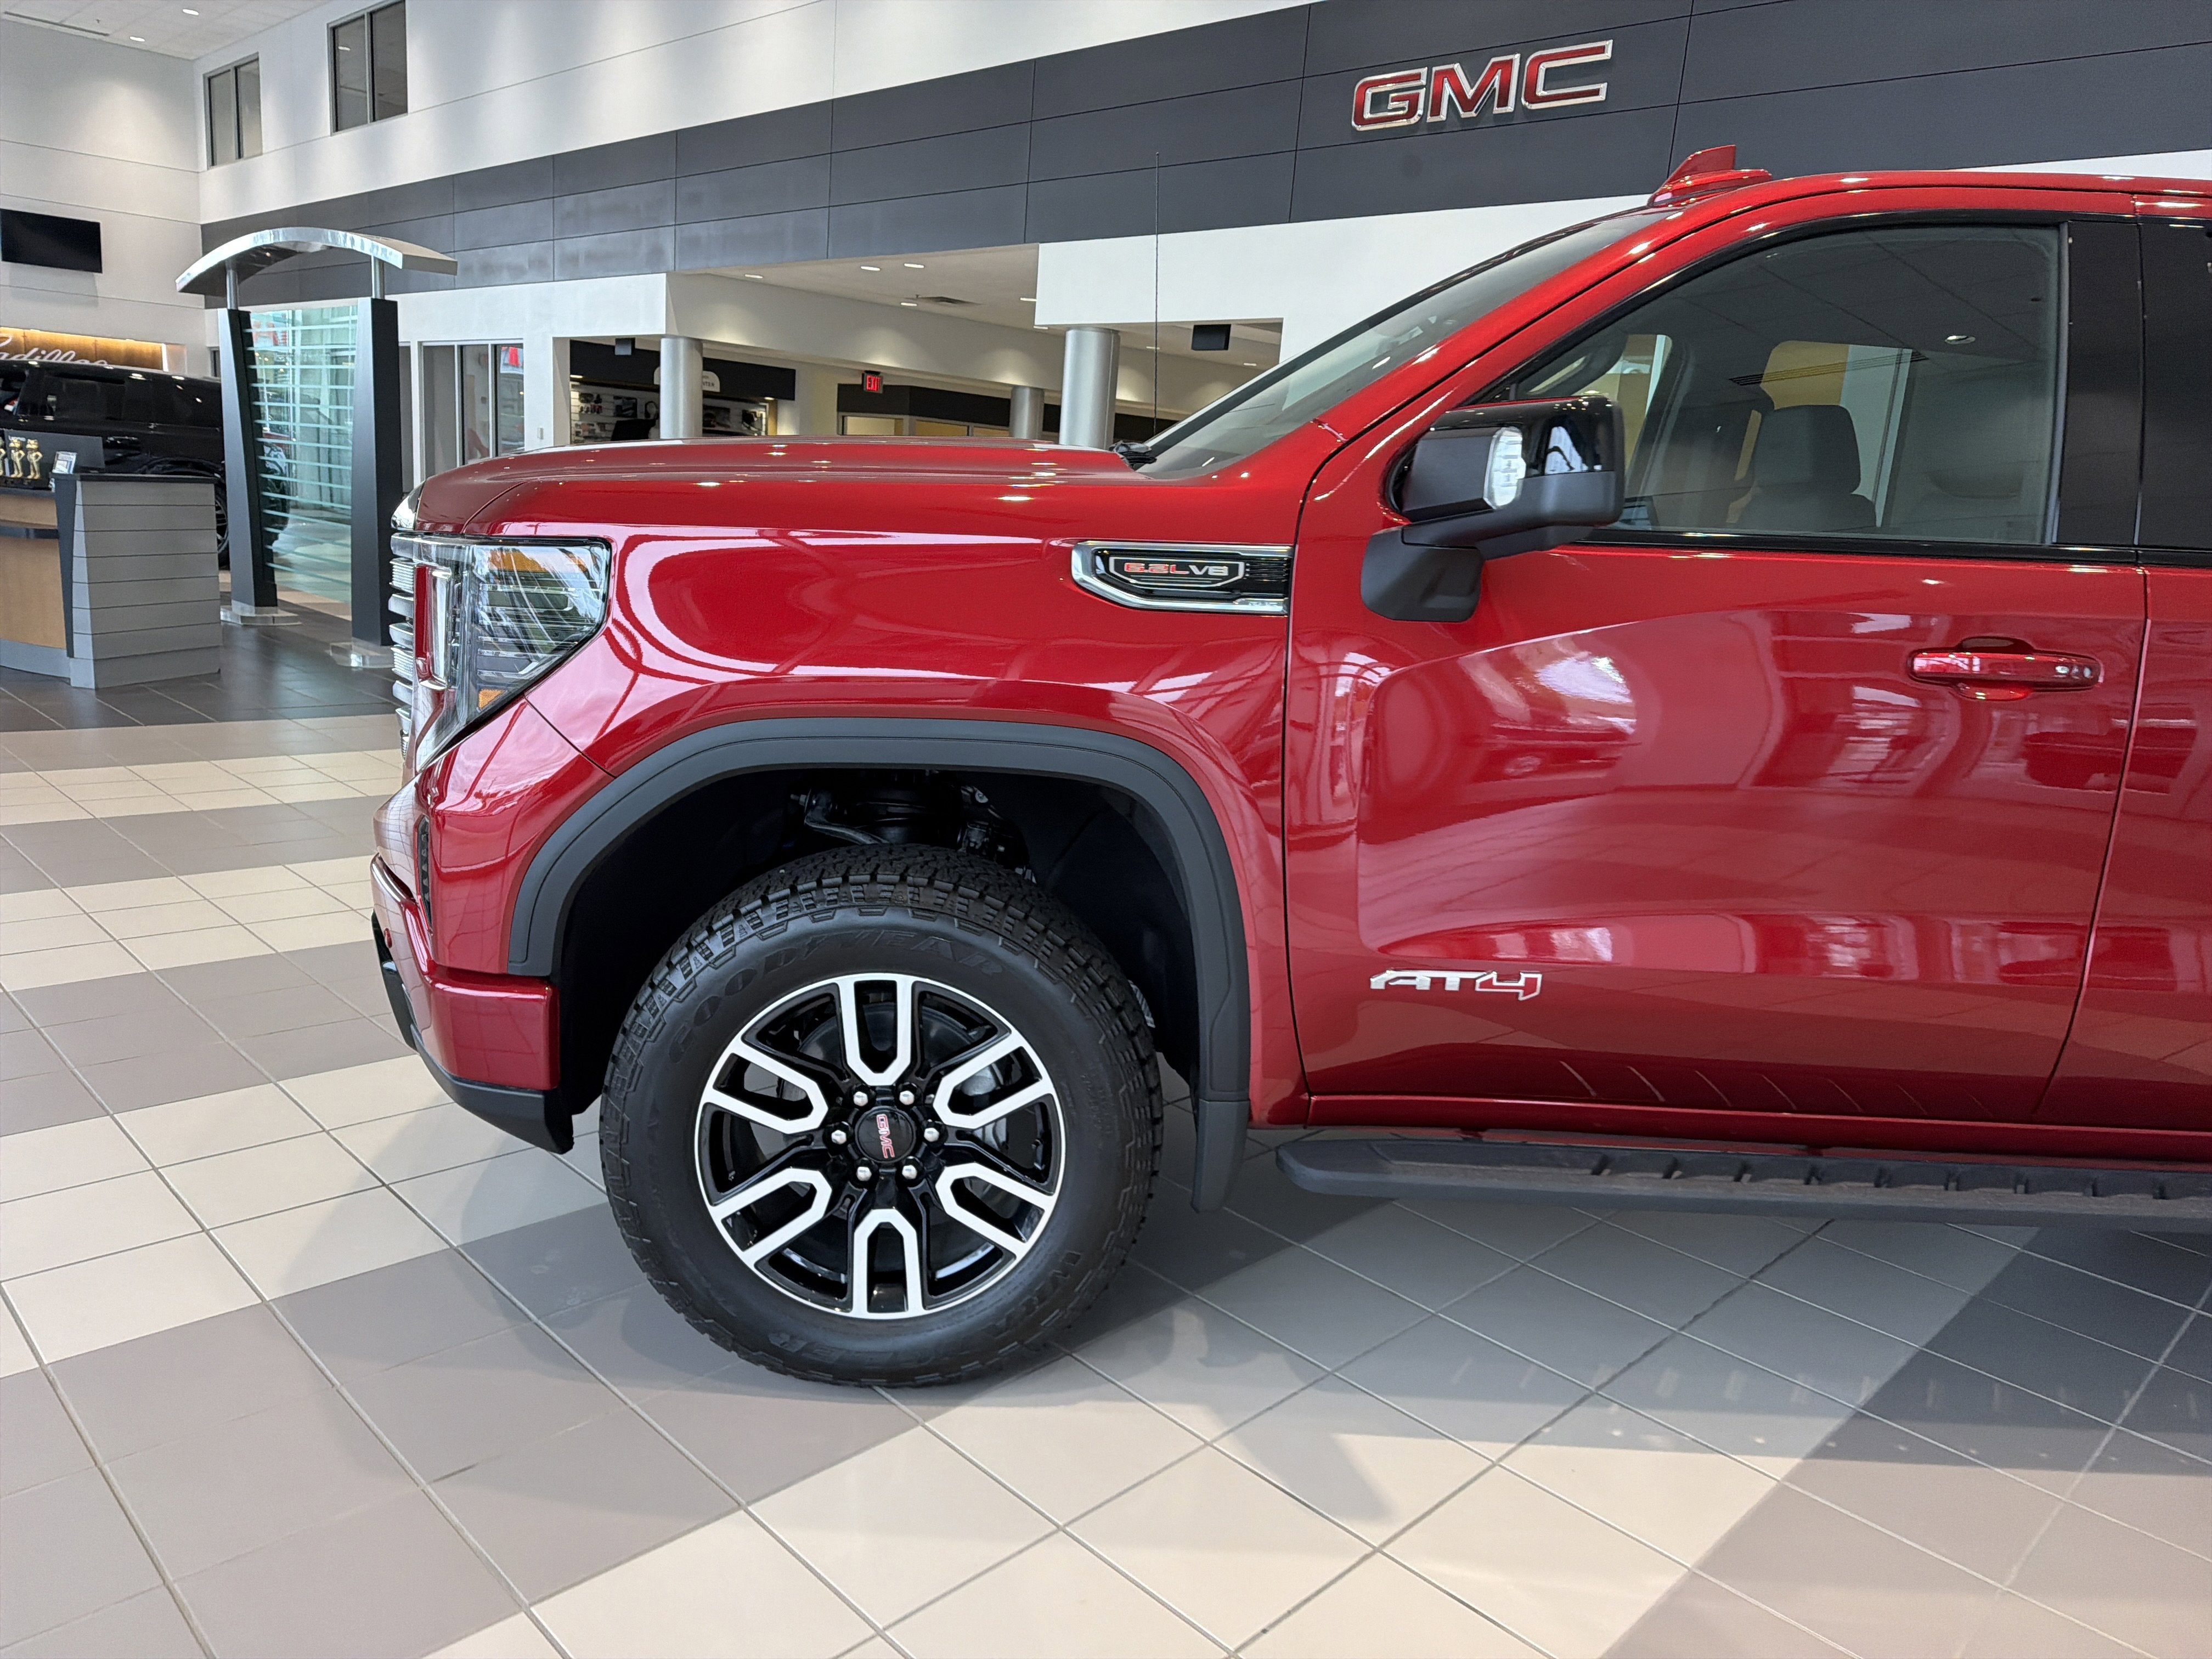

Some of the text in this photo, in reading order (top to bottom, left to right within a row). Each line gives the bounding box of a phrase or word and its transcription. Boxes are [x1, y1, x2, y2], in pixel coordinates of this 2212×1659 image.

[1352, 39, 1613, 131] GMC
[866, 375, 881, 392] EXIT
[668, 930, 1005, 1063] GOODYEAR
[1370, 969, 1543, 1001] AT4
[876, 1114, 895, 1159] GMC
